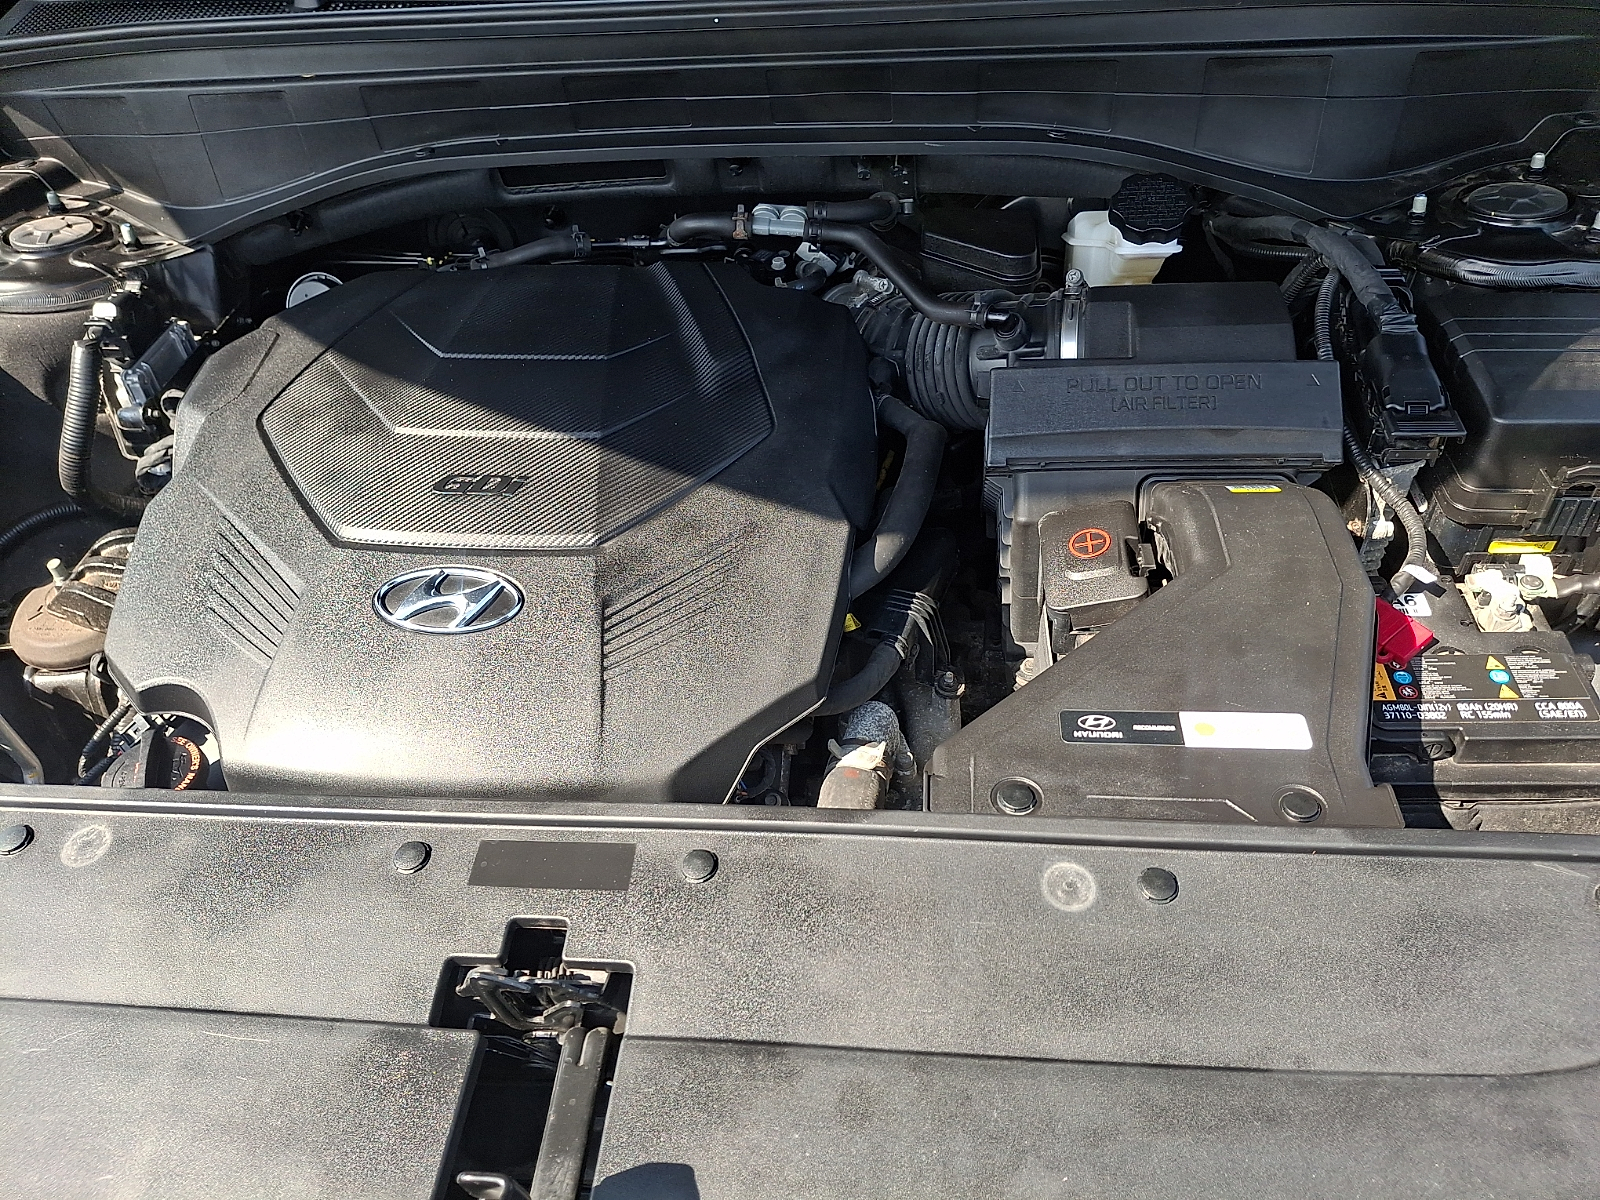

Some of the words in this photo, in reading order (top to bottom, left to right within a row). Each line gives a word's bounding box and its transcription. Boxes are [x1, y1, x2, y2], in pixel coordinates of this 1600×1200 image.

[1066, 377, 1118, 393] PULL
[1124, 375, 1166, 391] OUT
[1172, 374, 1199, 391] TO
[1205, 373, 1262, 390] OPEN
[432, 474, 530, 497] GDi
[1534, 702, 1556, 710] CCA
[1460, 710, 1476, 719] RC
[1477, 710, 1511, 719] 155min
[1073, 730, 1124, 739] HYUNDAI
